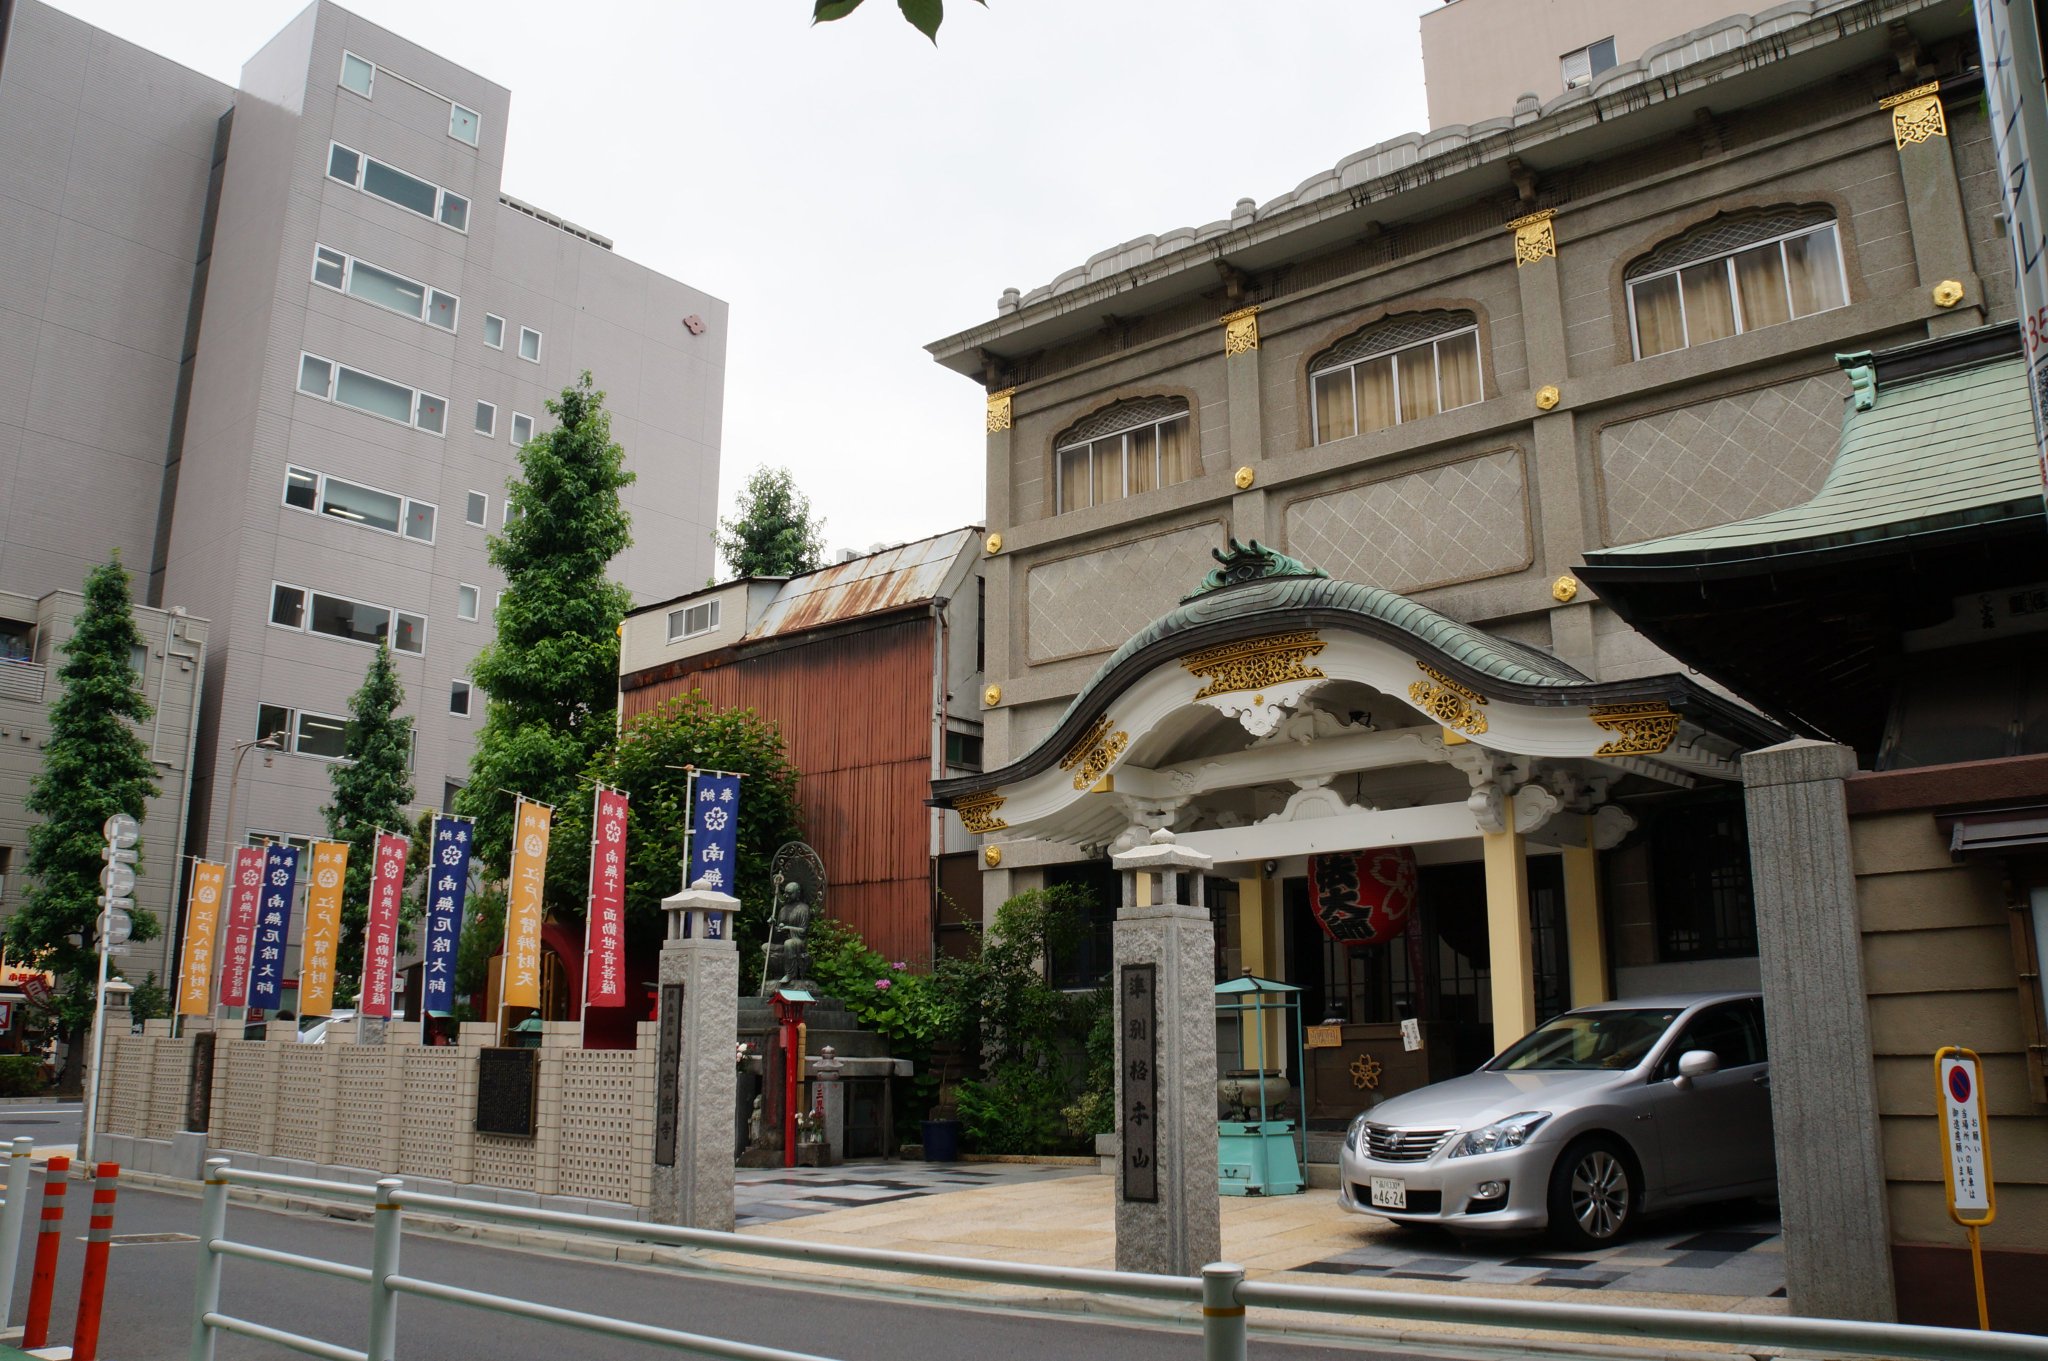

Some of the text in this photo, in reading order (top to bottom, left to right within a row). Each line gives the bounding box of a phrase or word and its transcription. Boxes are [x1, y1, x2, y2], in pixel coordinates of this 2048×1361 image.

[1961, 1108, 1976, 1199] 当場所への駐車は
[1972, 1118, 1981, 1153] お願い
